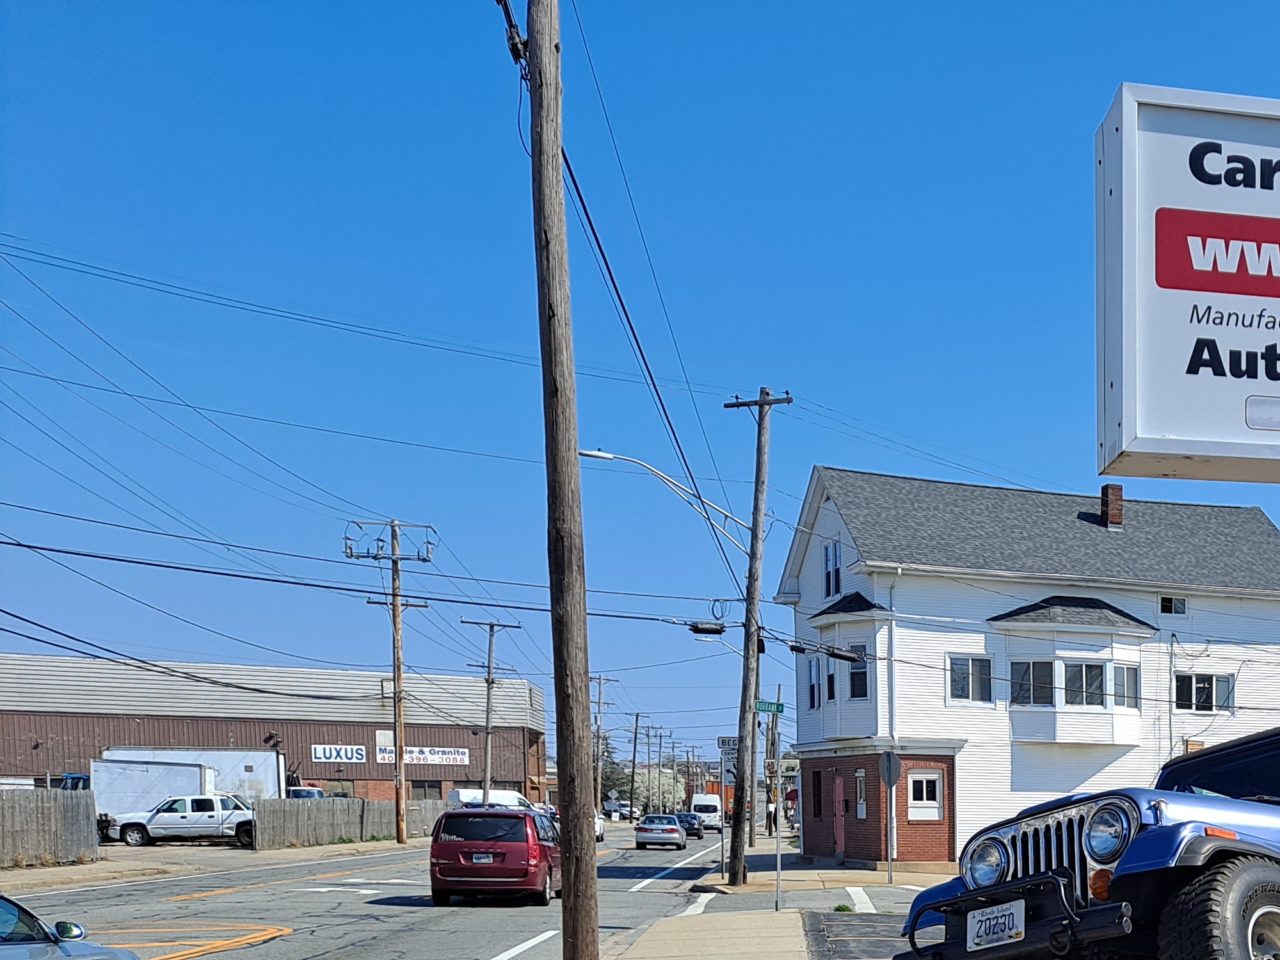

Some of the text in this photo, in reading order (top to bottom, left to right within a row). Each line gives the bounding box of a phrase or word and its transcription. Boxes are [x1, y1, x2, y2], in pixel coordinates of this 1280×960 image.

[721, 739, 737, 747] BEG
[313, 747, 364, 761] LUXUS
[378, 747, 414, 755] Male
[429, 748, 467, 756] Granite
[380, 756, 465, 764] 40-396-3088
[976, 912, 1014, 938] 20230
